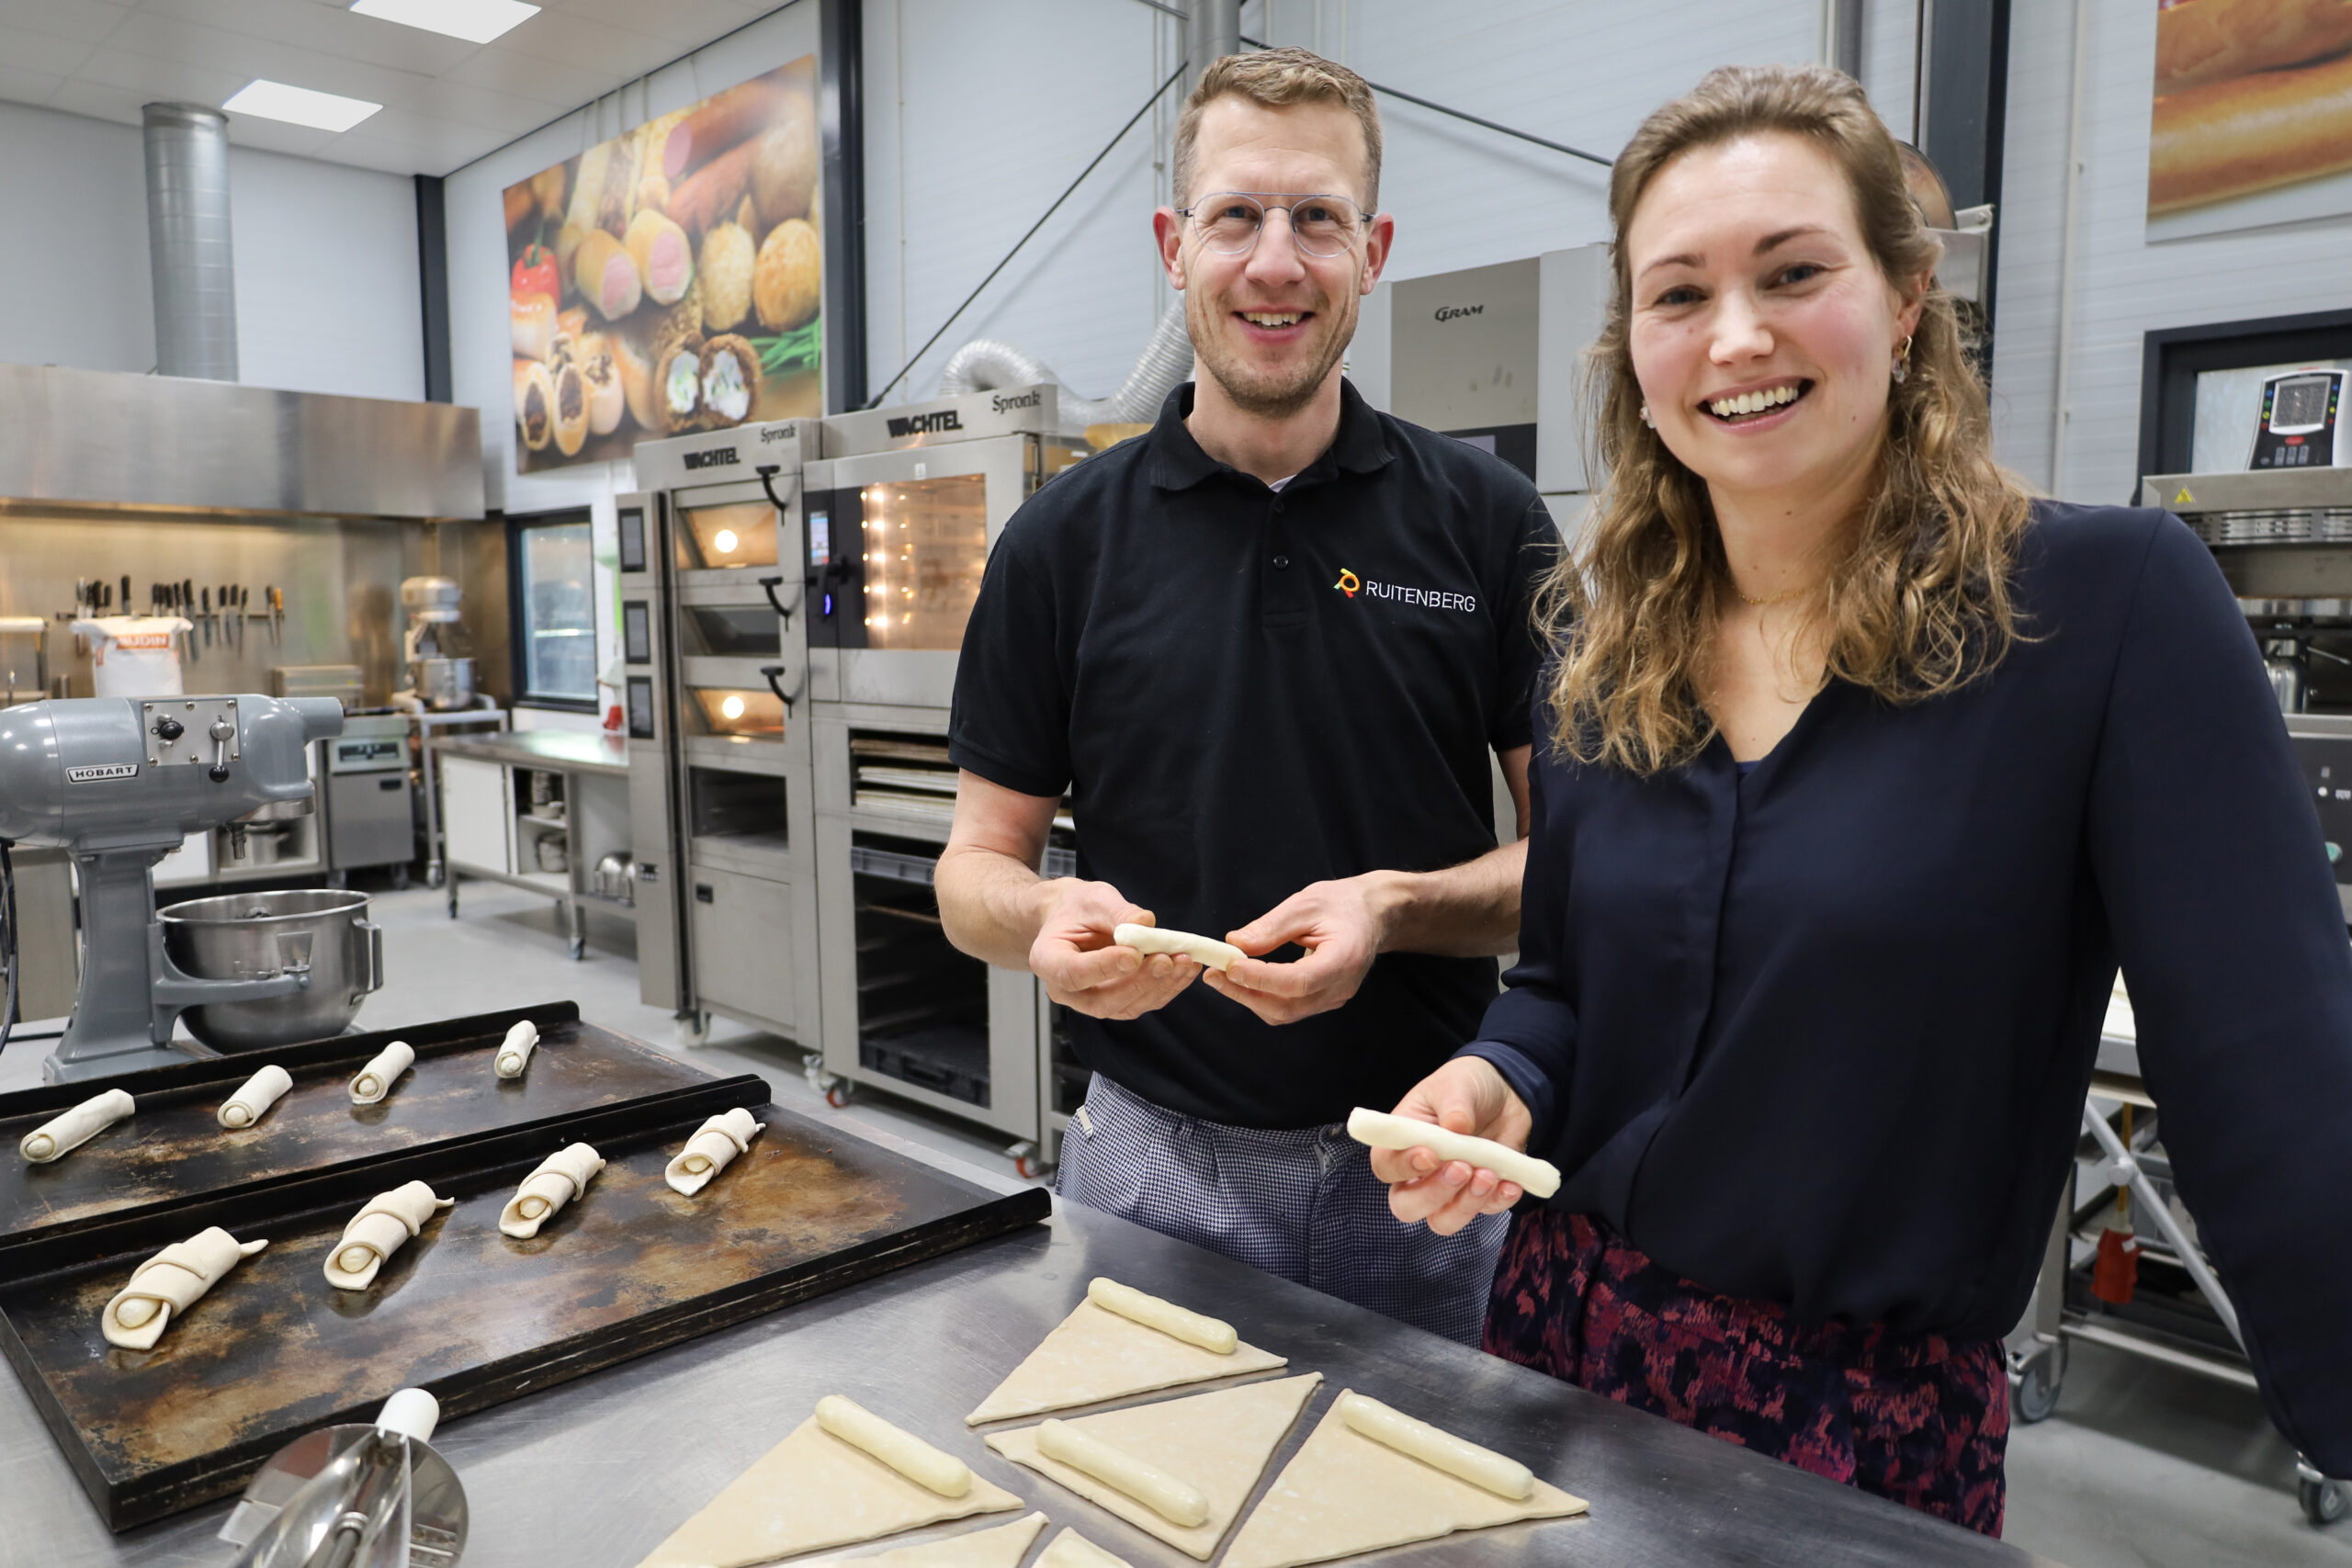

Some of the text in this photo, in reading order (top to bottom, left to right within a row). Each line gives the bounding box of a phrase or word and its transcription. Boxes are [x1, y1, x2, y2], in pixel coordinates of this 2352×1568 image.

[1435, 304, 1484, 322] GRAM
[992, 390, 1041, 414] Spronk
[887, 410, 963, 438] WACHTEL
[684, 446, 741, 470] WACHTEL
[1366, 581, 1476, 612] RUITENBERG
[75, 766, 133, 779] HOBART
